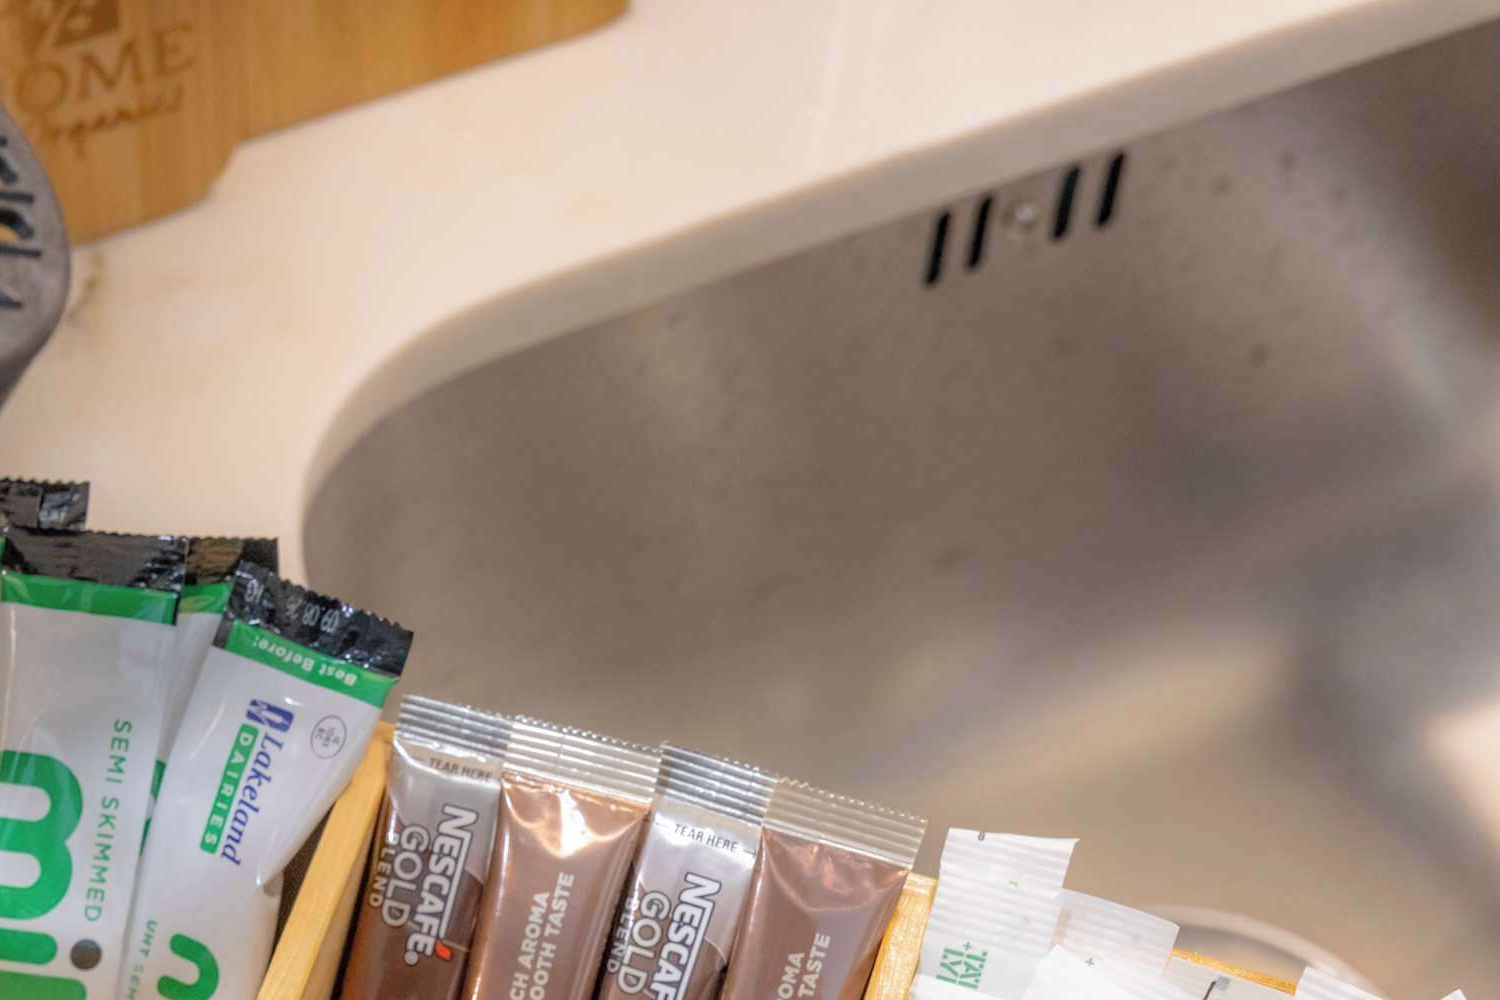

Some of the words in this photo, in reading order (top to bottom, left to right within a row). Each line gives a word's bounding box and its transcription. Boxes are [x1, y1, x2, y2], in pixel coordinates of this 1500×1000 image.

[13, 22, 197, 114] OME
[252, 634, 317, 673] Before:
[320, 661, 358, 687] Best
[105, 718, 133, 785] SEMI
[428, 757, 460, 776] TEAR
[461, 765, 494, 783] HERE
[204, 731, 255, 845] DAIRIES
[220, 728, 286, 866] Lakeland
[83, 796, 121, 922] SKIMMED
[368, 831, 400, 909] BLEND
[673, 822, 705, 843] TEAR
[705, 831, 739, 853] HERE
[381, 824, 431, 928] GOLD
[544, 871, 575, 938] TASTE
[142, 919, 158, 959] UHT
[517, 891, 551, 970] AROMA
[606, 895, 640, 974] BLEND
[617, 889, 672, 995] GOLD
[797, 931, 832, 999] TASTE
[935, 946, 966, 984] LYL
[957, 949, 989, 990] TAT
